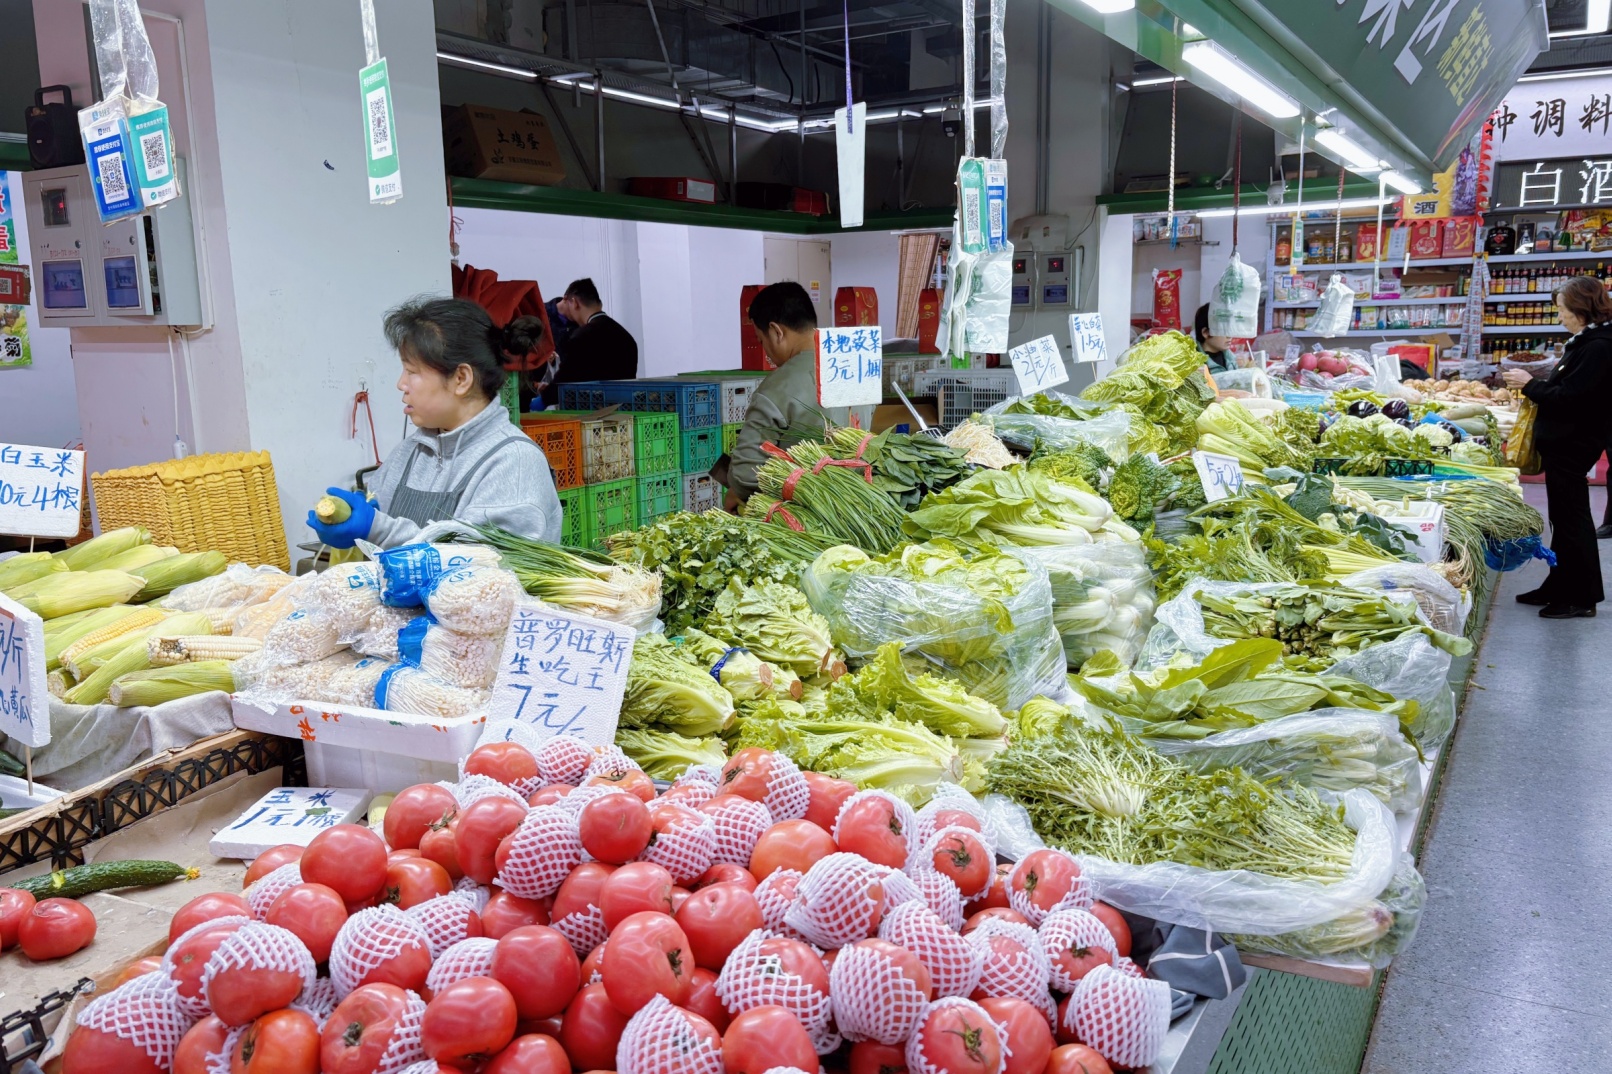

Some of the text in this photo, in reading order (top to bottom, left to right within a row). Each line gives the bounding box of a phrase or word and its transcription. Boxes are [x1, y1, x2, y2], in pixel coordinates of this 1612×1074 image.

[496, 128, 540, 150] 土鸡蛋
[1519, 160, 1612, 207] 白酒
[1012, 338, 1055, 361] 小油菜
[828, 354, 881, 384] 3元1捆
[1021, 356, 1057, 386] 2元/斤
[1, 446, 75, 478] 白玉米
[512, 612, 630, 673] 普罗旺斯
[509, 652, 604, 691] 生吃王
[507, 683, 587, 739] 7元/
[265, 789, 337, 807] 玉米
